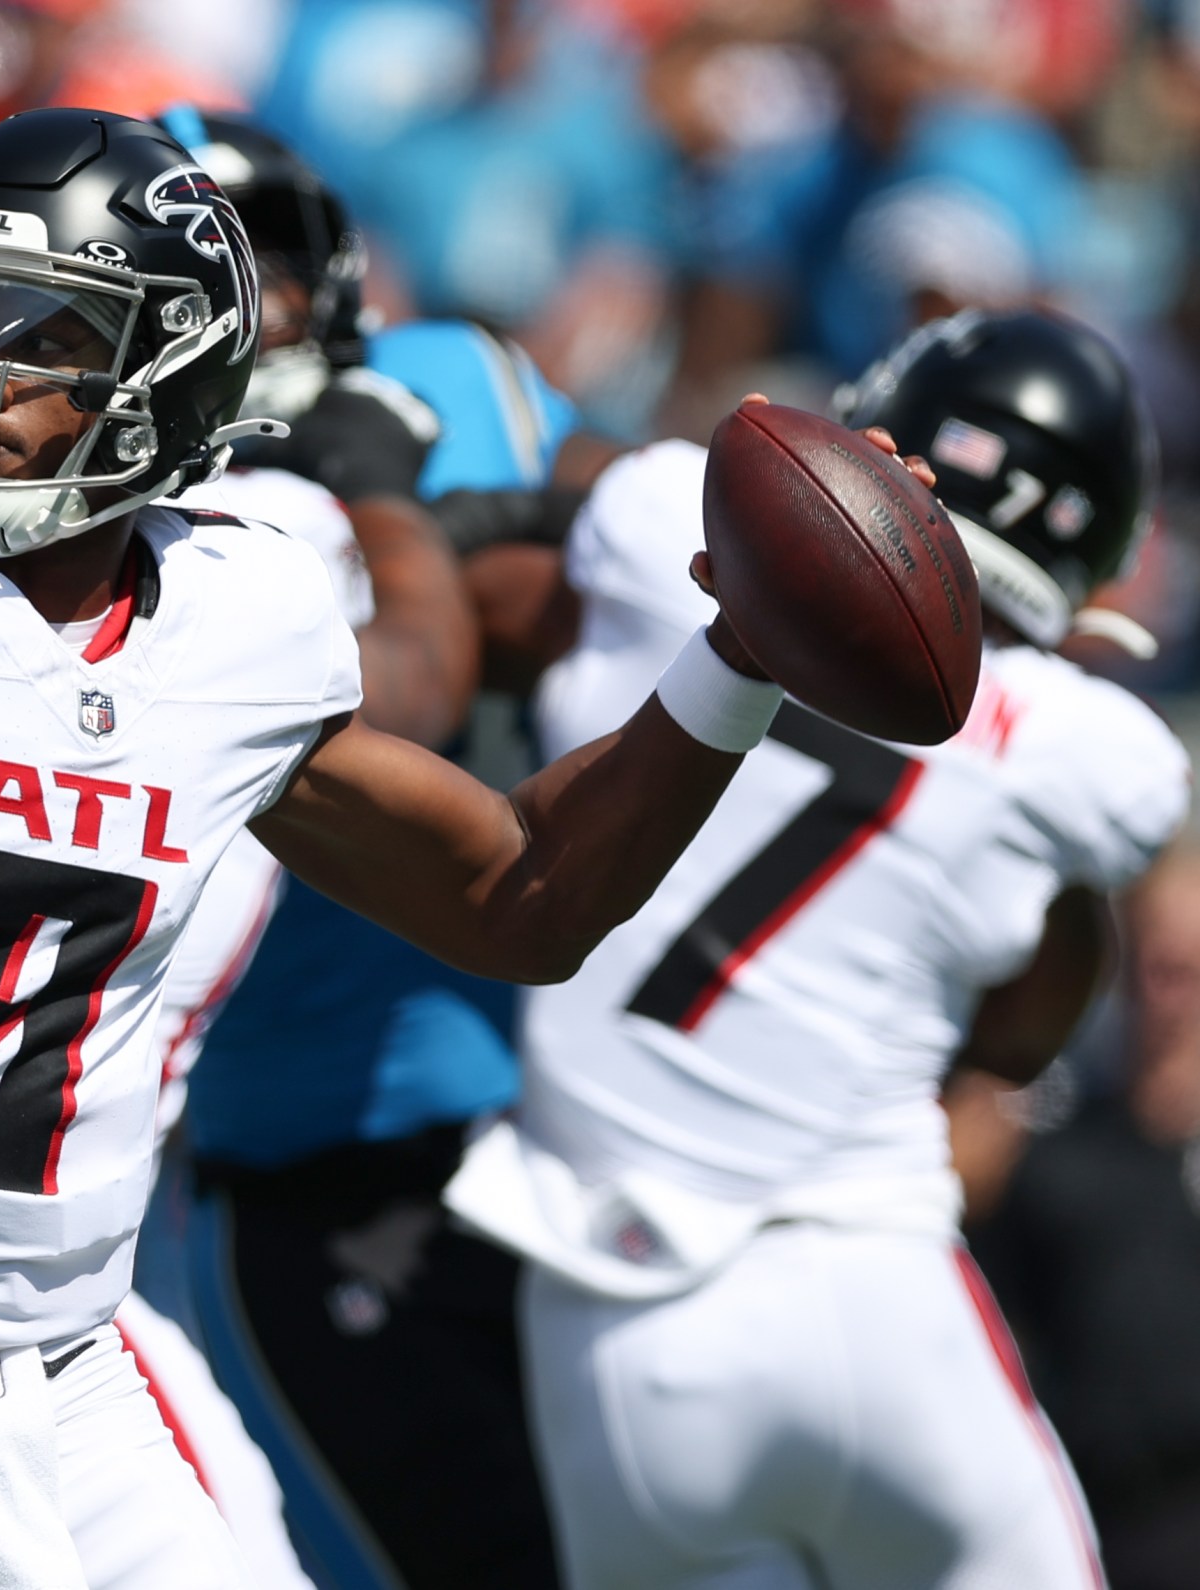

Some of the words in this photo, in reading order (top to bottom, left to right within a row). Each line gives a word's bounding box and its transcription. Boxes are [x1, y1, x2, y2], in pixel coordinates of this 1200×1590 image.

[987, 467, 1046, 531] 7
[870, 502, 916, 573] Wilson
[84, 708, 113, 730] NFL
[622, 697, 926, 1032] 7
